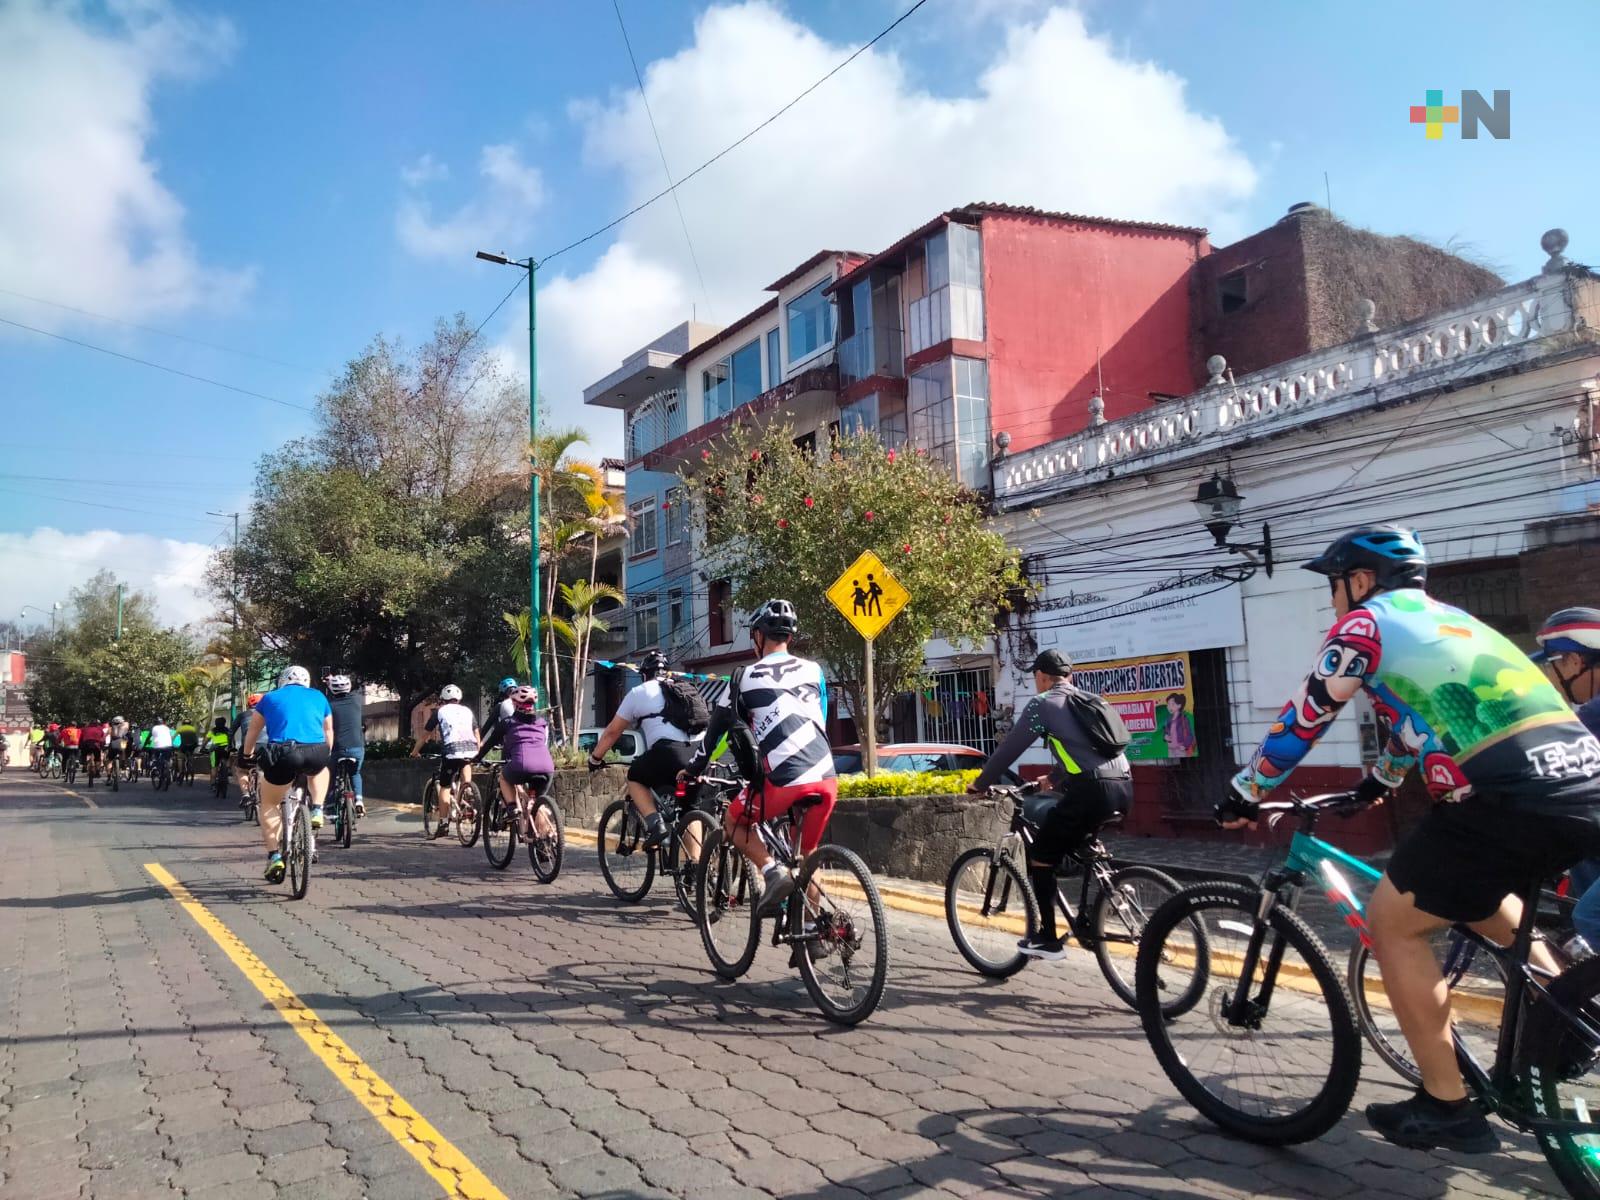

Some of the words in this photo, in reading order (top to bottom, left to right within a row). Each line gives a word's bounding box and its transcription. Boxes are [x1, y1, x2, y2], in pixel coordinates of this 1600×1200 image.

[1071, 666, 1137, 694] NSCRIPCIONES
[1139, 660, 1185, 691] ABIERTAS
[1189, 895, 1240, 905] MAXXIS
[1530, 1065, 1560, 1149] MXXIS
